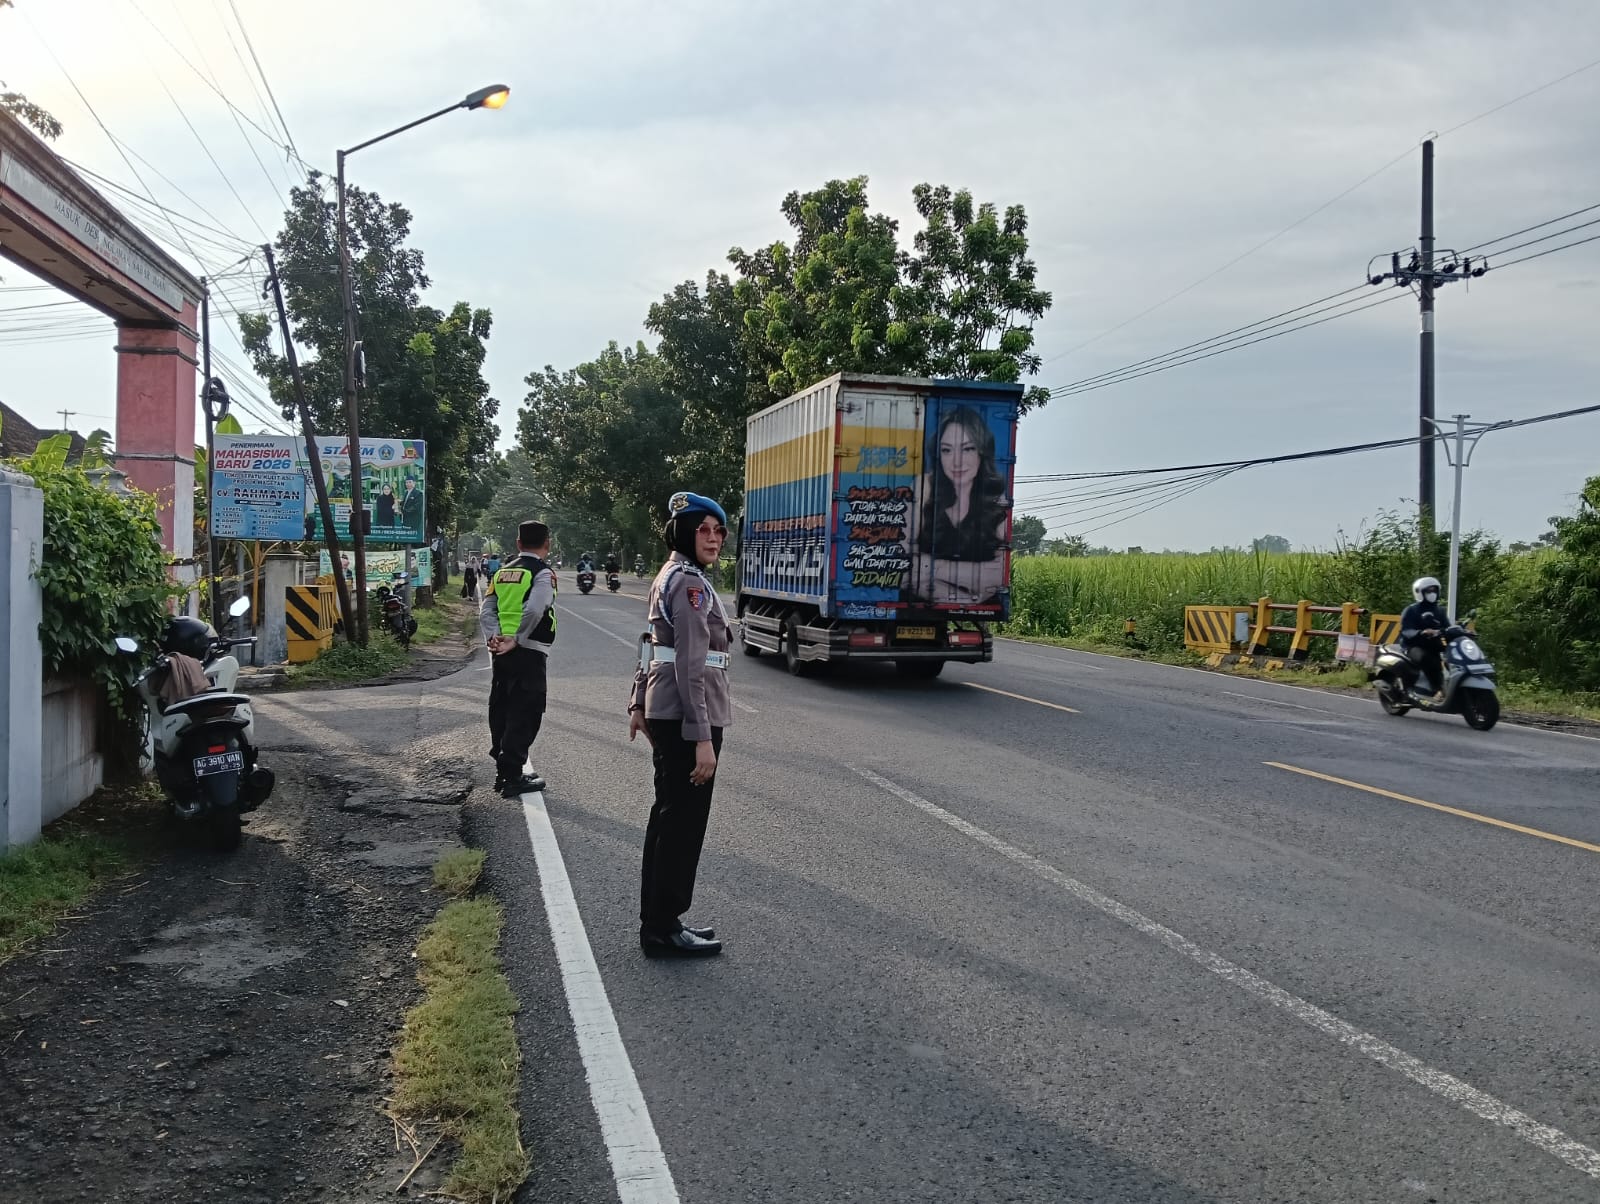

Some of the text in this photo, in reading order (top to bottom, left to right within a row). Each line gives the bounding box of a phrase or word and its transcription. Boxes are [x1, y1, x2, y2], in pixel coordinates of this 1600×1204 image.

[55, 199, 81, 227] MASUK
[84, 221, 100, 240] DES
[215, 449, 291, 459] MAHASISWA
[216, 459, 291, 469] BARU 2026
[234, 488, 300, 500] RAHMATAN
[197, 753, 240, 768] AG 3910 VAN
